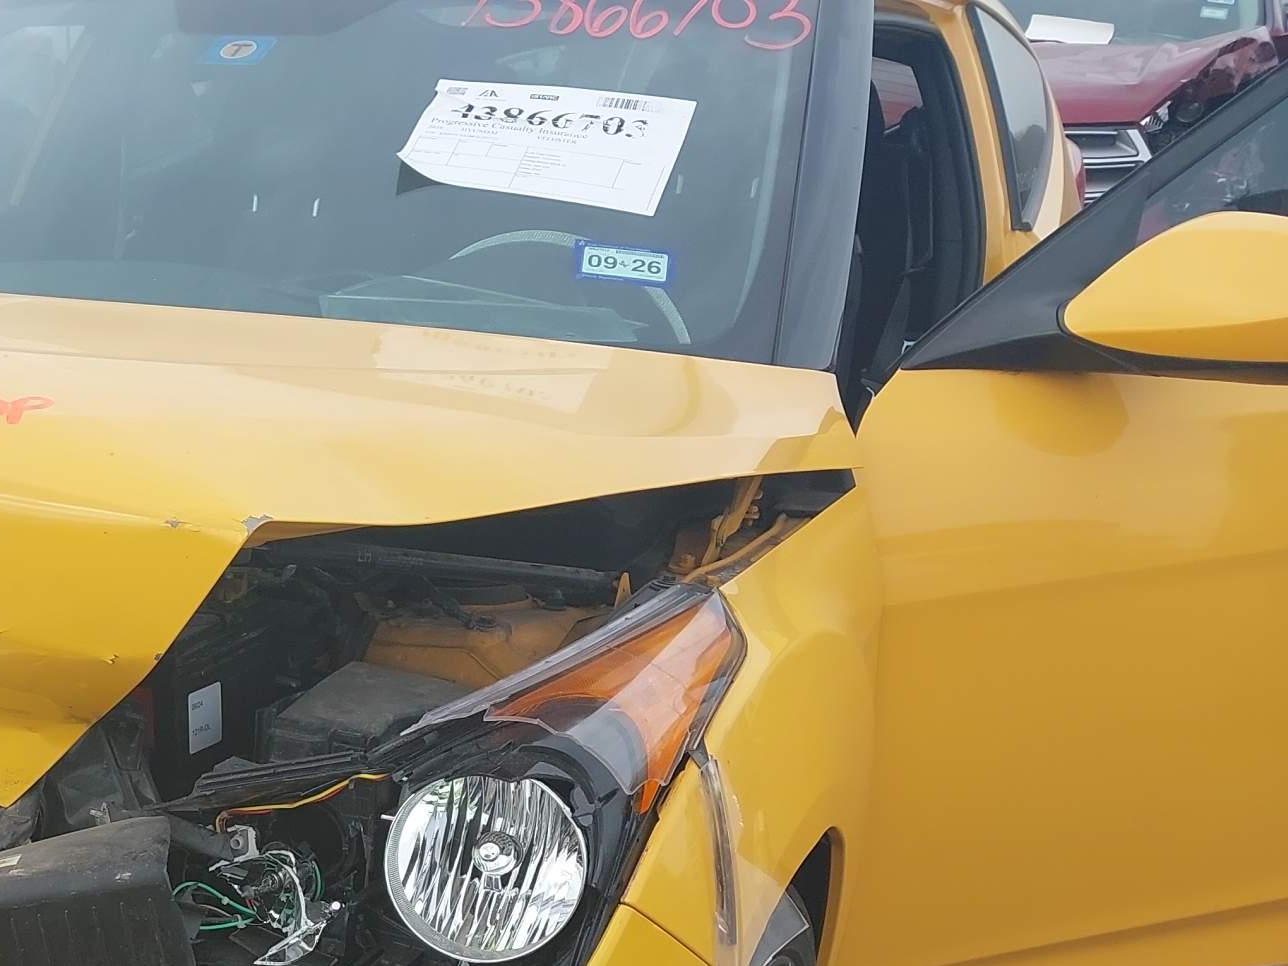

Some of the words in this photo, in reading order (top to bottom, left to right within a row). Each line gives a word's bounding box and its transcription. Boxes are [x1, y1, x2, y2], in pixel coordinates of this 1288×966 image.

[431, 117, 490, 128] Progressive
[491, 122, 534, 134] Casualty
[538, 127, 588, 139] Insurance
[450, 103, 649, 138] 43866703
[587, 254, 618, 269] 09
[631, 258, 662, 274] 26
